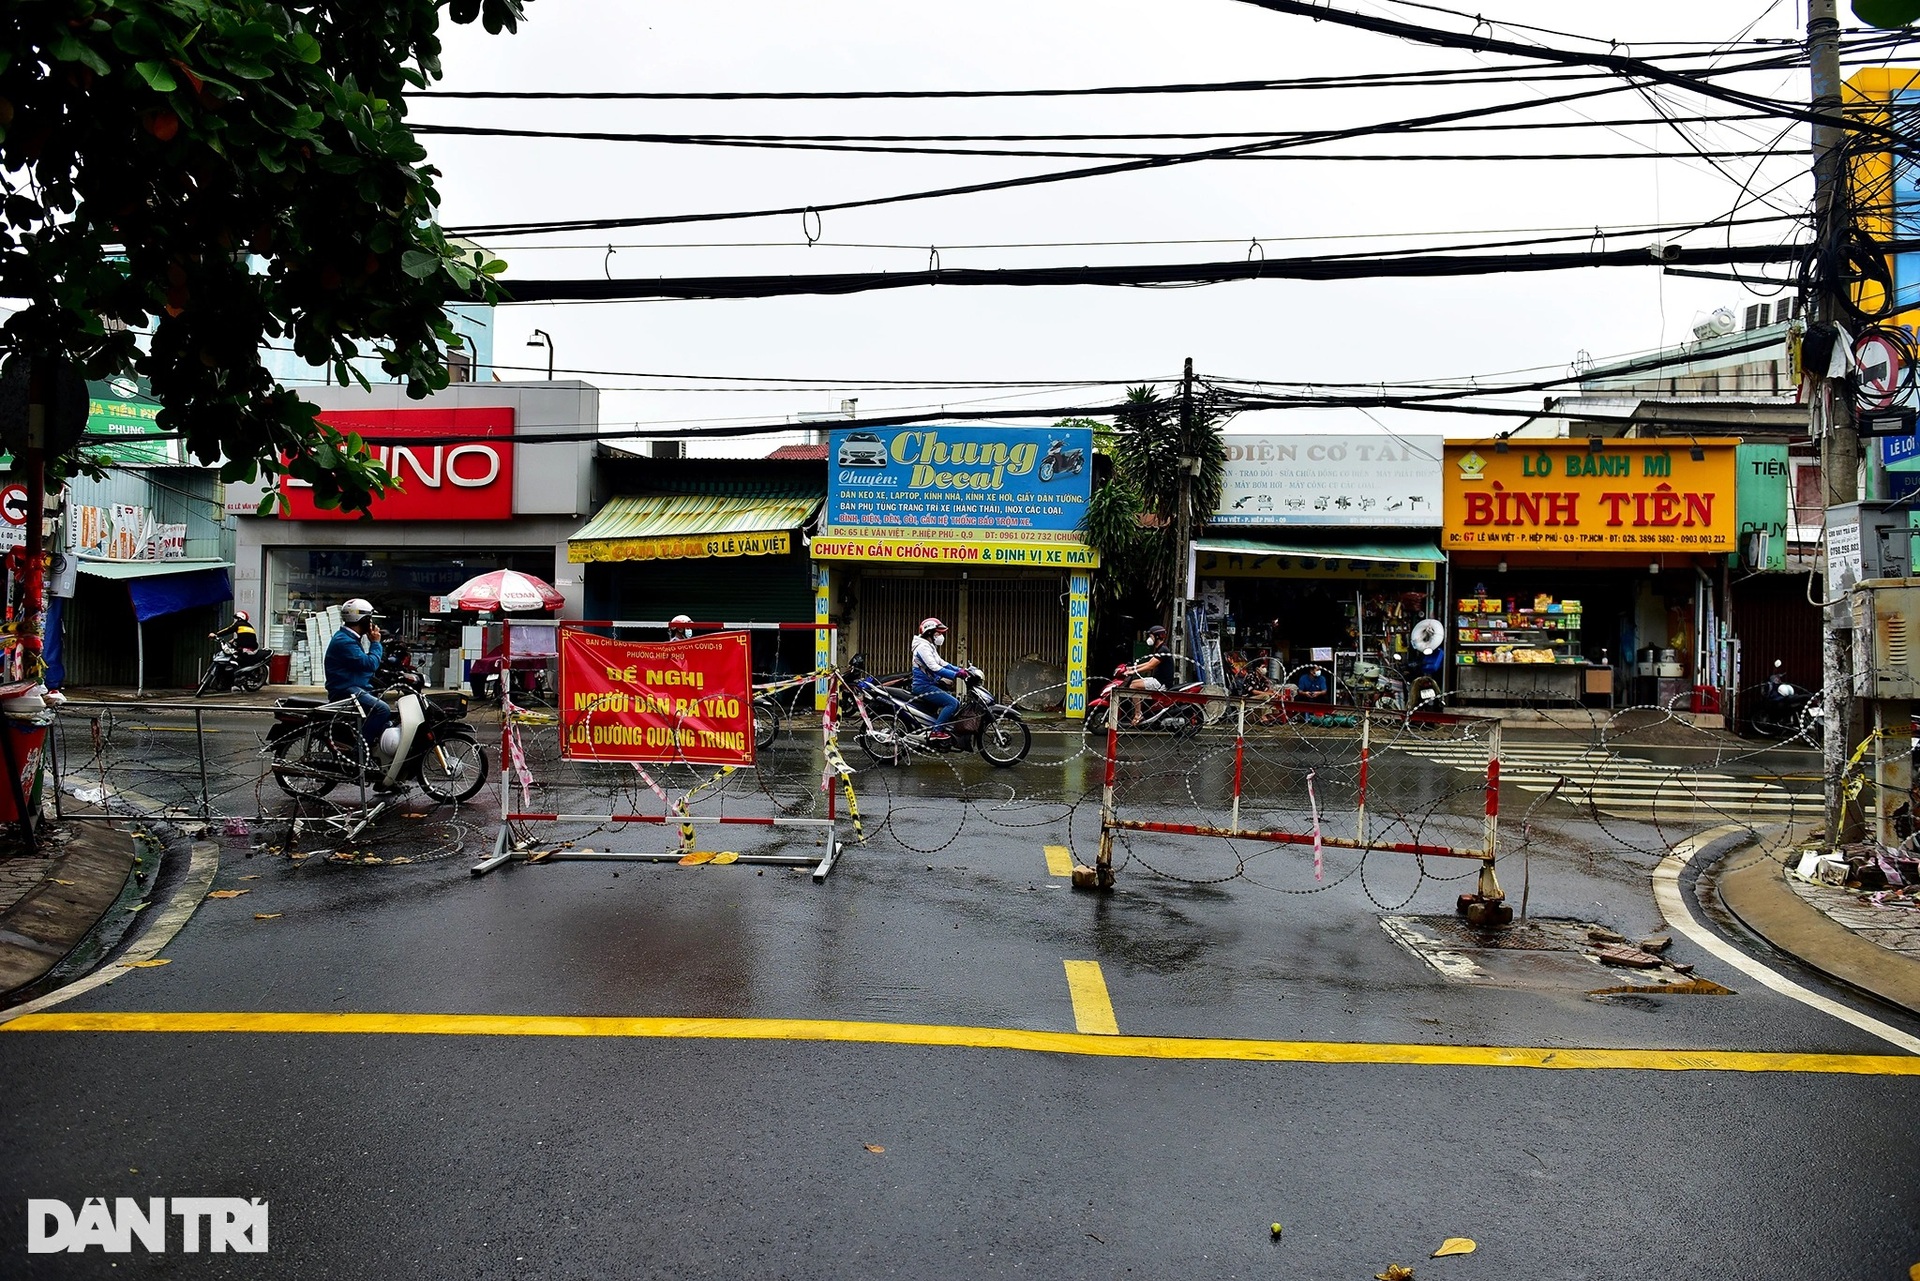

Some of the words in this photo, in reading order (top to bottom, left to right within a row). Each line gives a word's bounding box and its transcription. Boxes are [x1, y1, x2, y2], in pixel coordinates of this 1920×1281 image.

[890, 431, 1038, 475] Chung
[1226, 439, 1298, 465] ĐIỆN
[1307, 441, 1348, 461] CƠ
[1522, 450, 1552, 477] LÒ
[1643, 448, 1672, 477] MÌ
[838, 470, 898, 487] Chuyên:
[908, 464, 1005, 490] Decal
[858, 491, 874, 499] KEO
[876, 491, 888, 501] XE,
[890, 492, 922, 501] LAPTOP,
[924, 491, 943, 500] KÍNH
[945, 492, 963, 501] NHÀ,
[966, 493, 984, 502] KÍNH
[987, 494, 996, 502] XE
[1463, 480, 1580, 527] BÌNH
[1599, 482, 1716, 527] TIÊN
[840, 502, 856, 510] BÁN
[858, 503, 873, 511] PHỤ
[876, 503, 897, 511] TÙNG
[899, 503, 923, 512] TRANG
[926, 503, 938, 512] TRÍ
[940, 504, 950, 512] XE
[953, 504, 977, 513] (HÀNG
[1025, 505, 1041, 514] CÁC
[1043, 507, 1064, 515] LOẠI.
[1020, 517, 1033, 527] XE.
[707, 541, 718, 553] 63
[722, 538, 735, 553] LÊ
[738, 537, 759, 552] VĂN
[763, 535, 786, 553] VIỆT
[860, 527, 869, 536] LÊ
[871, 528, 886, 537] VĂN
[888, 527, 905, 538] VIỆT
[938, 529, 954, 538] PHÚ
[961, 531, 974, 539] Q.9
[999, 531, 1018, 539] 0961
[1021, 532, 1035, 540] 072
[1037, 532, 1051, 540] 732
[1450, 533, 1462, 541] ĐC:
[1463, 532, 1474, 542] 67
[1477, 532, 1485, 542] LÊ
[1488, 533, 1500, 542] VĂN
[1502, 532, 1515, 543] VIỆT
[1521, 534, 1527, 542] P.
[1529, 532, 1543, 543] HIỆP
[1545, 532, 1558, 542] PHÚ
[1564, 534, 1574, 543] Q.9
[1580, 534, 1603, 542] TP.HCM
[1639, 535, 1656, 543] 3896
[1658, 535, 1674, 543] 3802
[1680, 535, 1698, 543] 0903
[1699, 535, 1712, 543] 003
[1714, 535, 1726, 543] 212
[815, 542, 865, 556] CHUYÊN
[867, 541, 892, 557] GẮN
[896, 542, 939, 558] CHỐNG
[942, 544, 978, 561] TRỘM
[982, 548, 992, 560] &
[995, 549, 1026, 562] ĐỊNH
[1030, 550, 1042, 564] VỊ
[1046, 550, 1062, 562] XE
[1066, 548, 1095, 563] MÁY
[1071, 577, 1088, 594] MUA
[1071, 595, 1088, 617] BÁN
[1073, 621, 1083, 639] XE
[585, 638, 600, 646] BAN
[694, 643, 723, 651] COVID-19
[1072, 641, 1083, 663] CŨ
[606, 664, 638, 685] ĐỀ
[646, 669, 704, 690] NGHỊ
[1070, 666, 1083, 688] GIÁ
[574, 689, 629, 713] NGƯỜI
[634, 693, 670, 716] DÂN
[676, 698, 700, 717] RA
[703, 693, 740, 719] VÀO
[1068, 693, 1084, 711] CAO
[594, 722, 642, 746] ĐƯỜNG
[646, 727, 695, 748] QUANG
[699, 730, 746, 751] TRUNG
